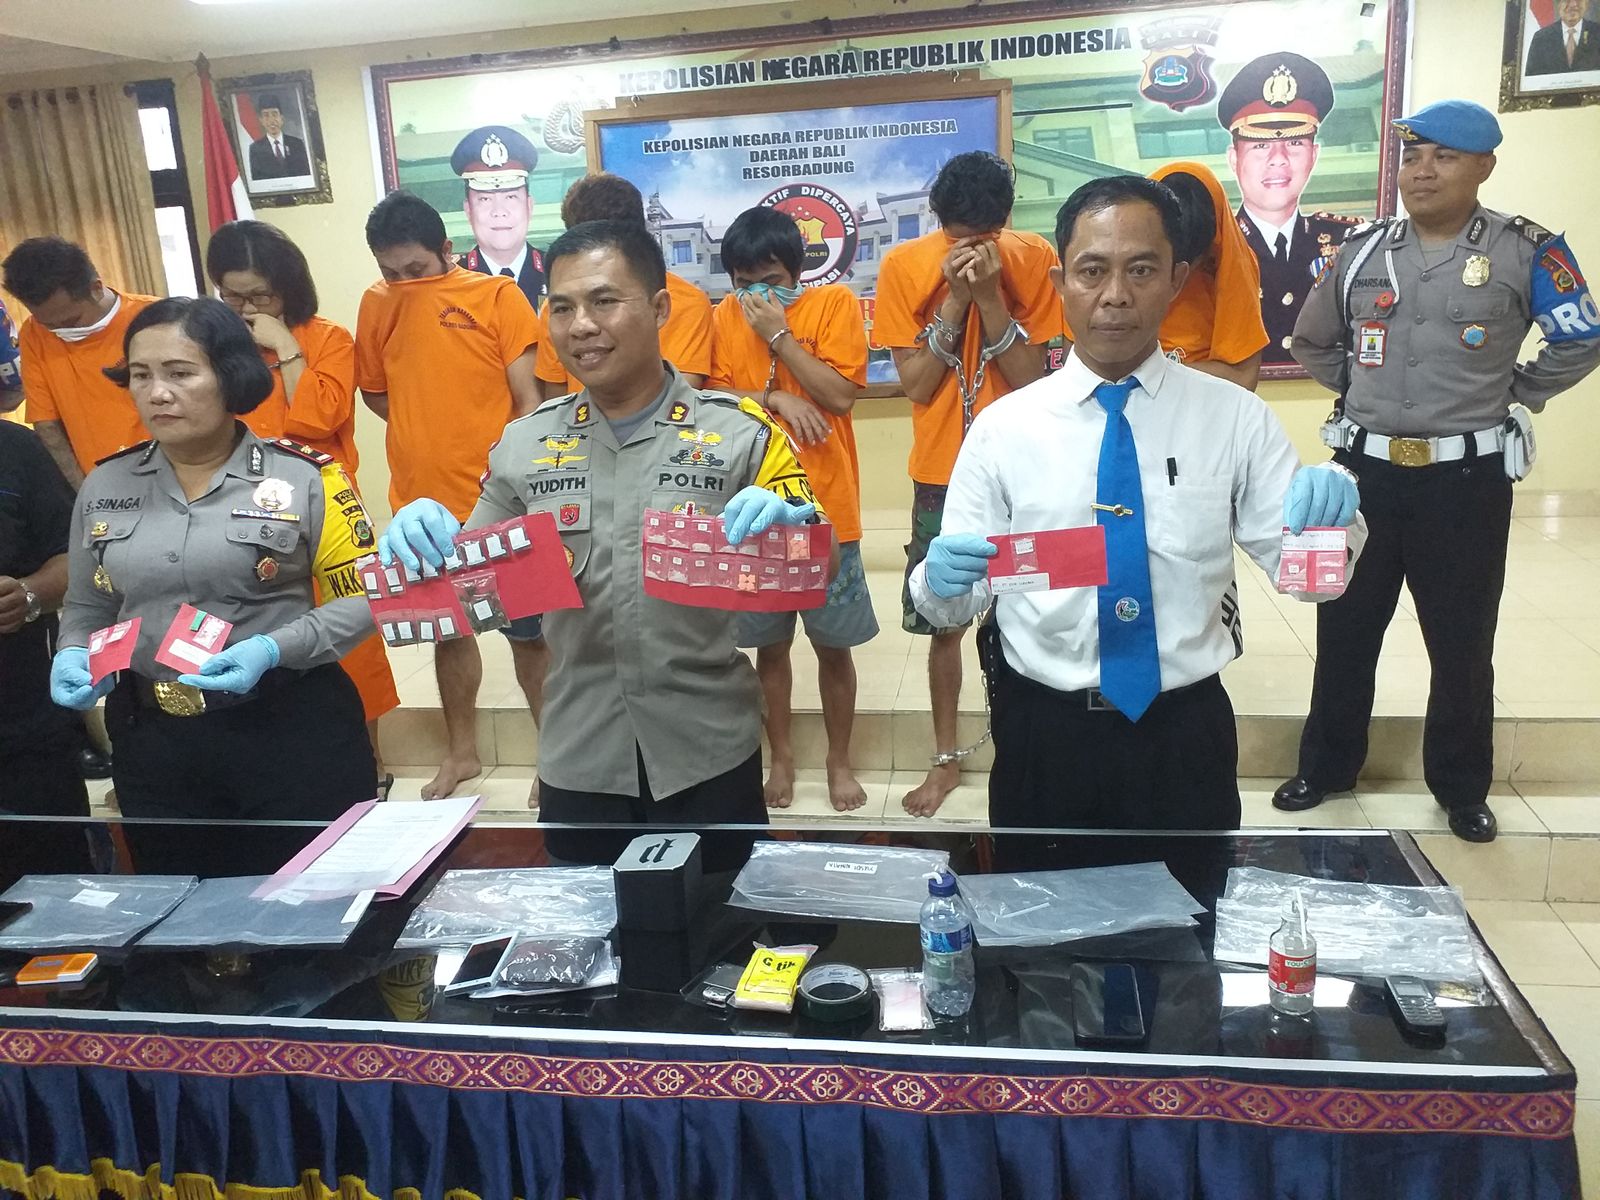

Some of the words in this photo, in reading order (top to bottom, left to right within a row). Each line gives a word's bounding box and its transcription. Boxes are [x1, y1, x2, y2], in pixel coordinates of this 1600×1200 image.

[619, 60, 756, 93] KEPOLISIAN
[762, 50, 857, 80] NEGARA
[864, 39, 985, 72] REPUBLIK
[991, 27, 1131, 61] INDONESIA
[643, 136, 729, 153] KEPOLISIAN
[733, 131, 792, 147] NEGARA
[795, 125, 869, 142] REPUBLIK
[872, 120, 957, 137] INDONESIA
[750, 147, 809, 163] DAERAH
[812, 145, 846, 158] BALI
[742, 161, 855, 180] RESORBADUNG
[801, 186, 855, 236] DIPERCAYA
[529, 476, 586, 496] YUDITH
[658, 472, 724, 492] POLRI
[95, 496, 141, 511] SINAGA
